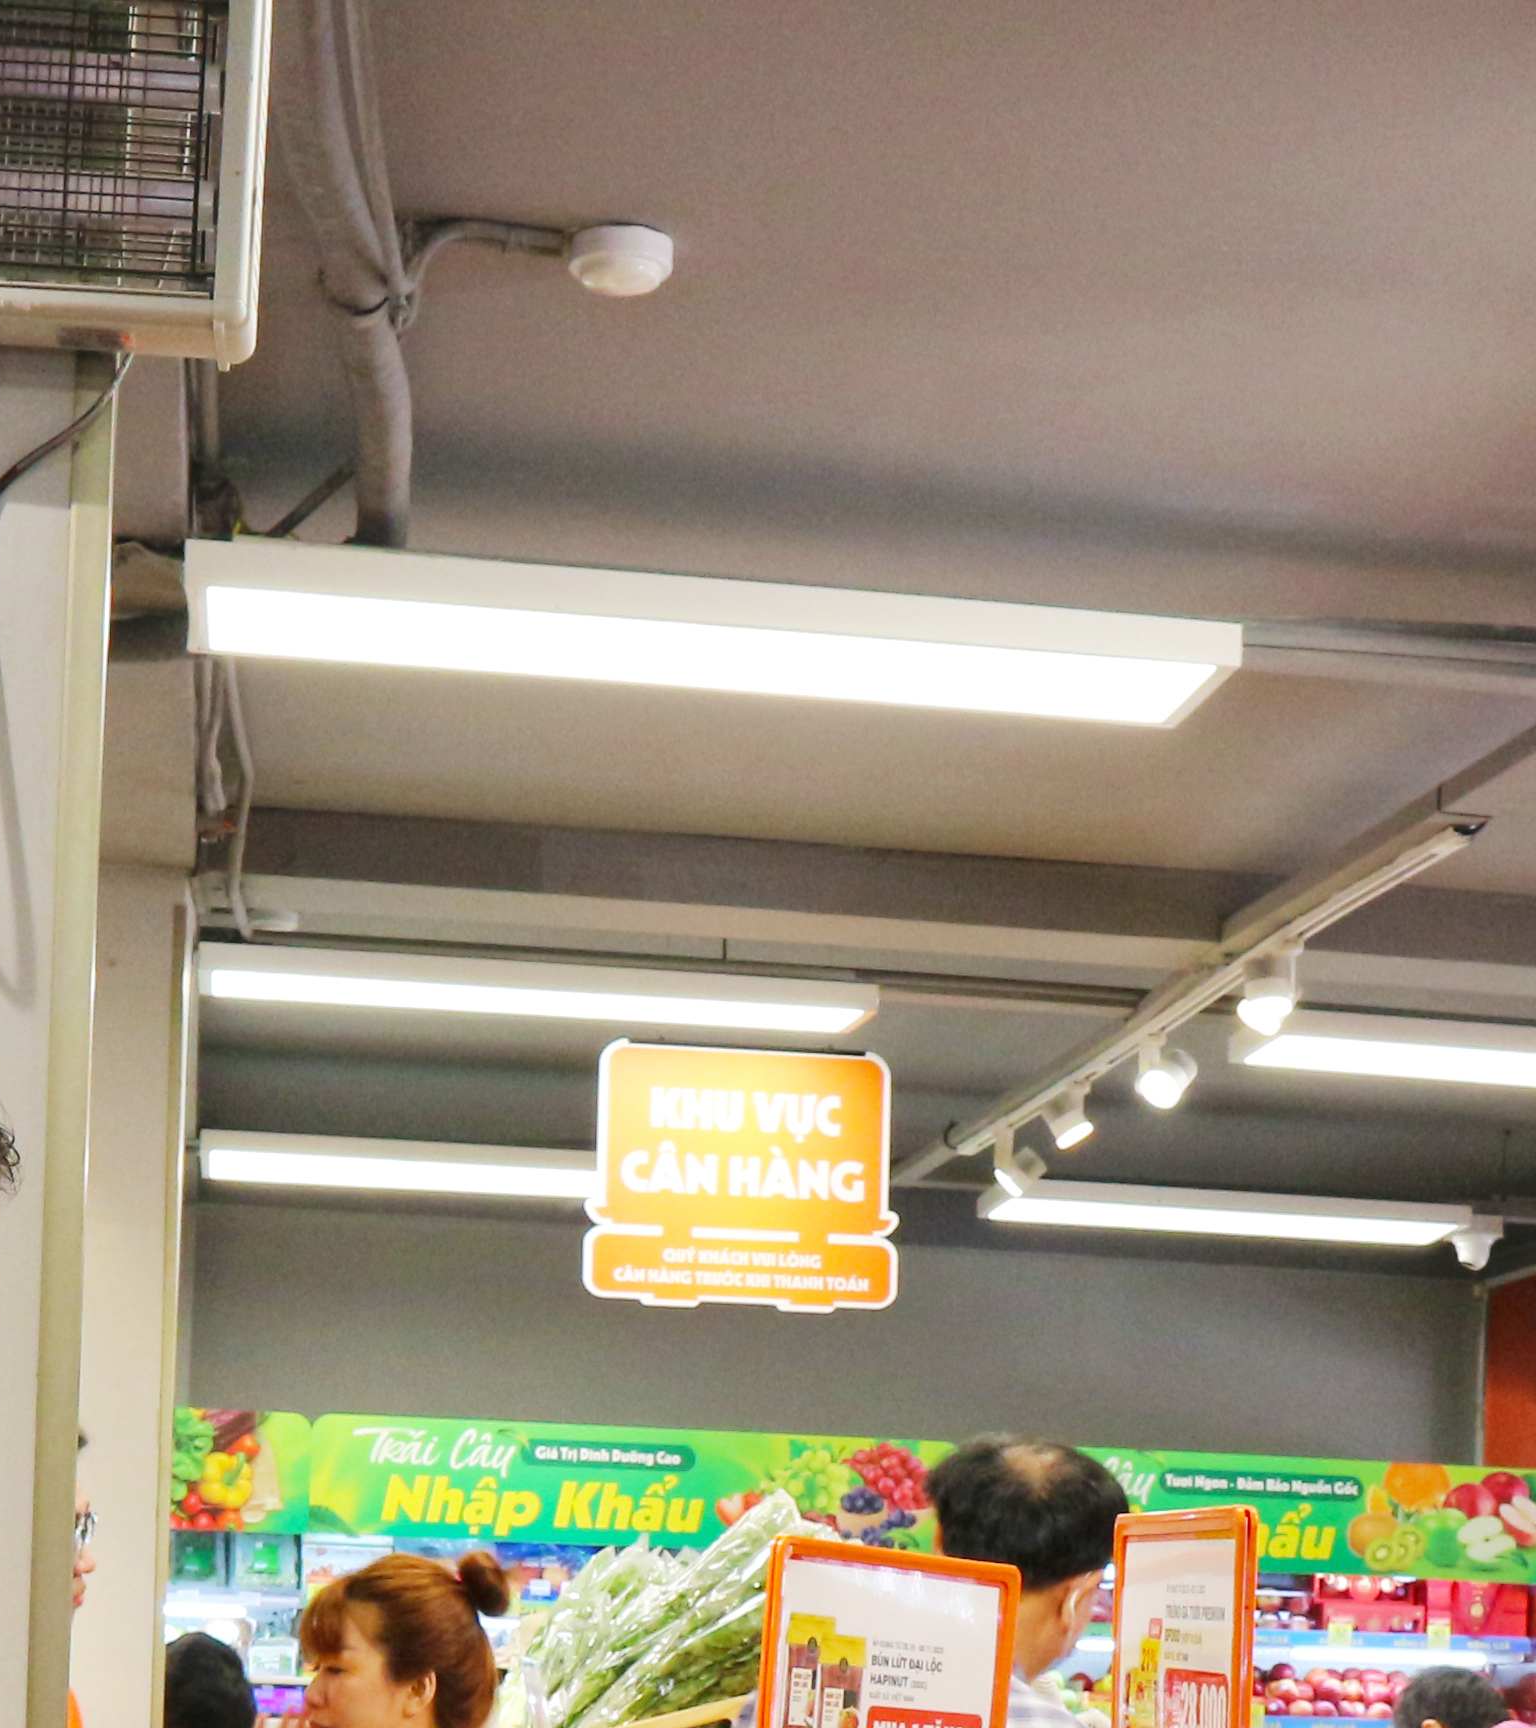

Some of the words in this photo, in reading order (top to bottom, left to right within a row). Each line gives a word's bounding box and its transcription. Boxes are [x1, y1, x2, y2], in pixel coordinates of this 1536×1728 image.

[649, 1086, 745, 1132] KHU
[752, 1091, 842, 1144] VỰC
[620, 1140, 719, 1196] CÂN
[728, 1146, 865, 1203] HÀNG
[698, 1247, 749, 1266] KHÁCH
[751, 1251, 776, 1267] VUI
[778, 1249, 822, 1269] LÒNG
[613, 1264, 646, 1283] CÂN
[648, 1265, 692, 1285] HÀNG
[745, 1272, 771, 1288] KHI
[773, 1274, 824, 1291] THANH
[826, 1273, 870, 1293] TOÁN
[353, 1427, 442, 1465] Trái
[449, 1428, 515, 1477] Cây
[534, 1444, 559, 1461] Giá
[560, 1446, 579, 1464] Trị
[580, 1447, 610, 1462] Dinh
[656, 1451, 682, 1466] Cao
[1194, 1475, 1229, 1490] Ngon
[380, 1473, 543, 1537] Nhập
[553, 1474, 706, 1534] Khẩu
[871, 1651, 890, 1668] BÚN
[869, 1672, 909, 1688] HAPINUT
